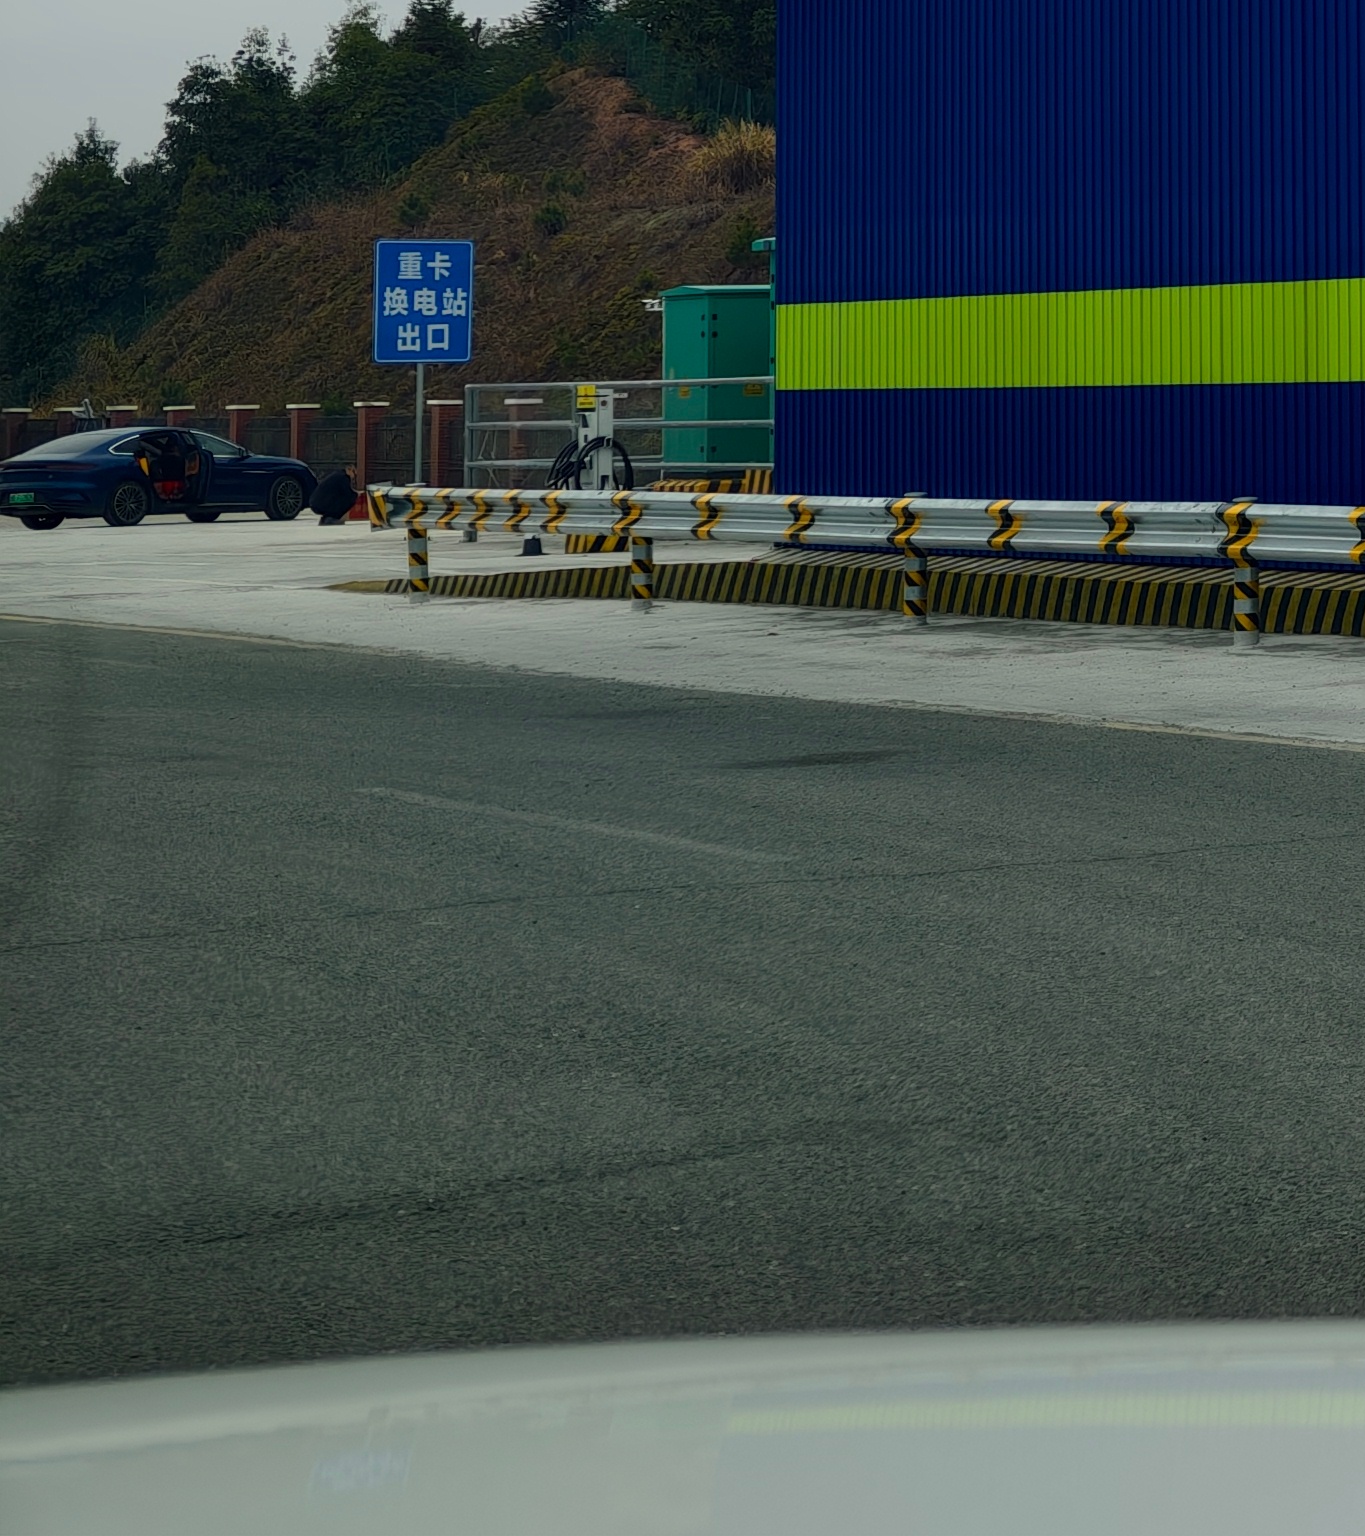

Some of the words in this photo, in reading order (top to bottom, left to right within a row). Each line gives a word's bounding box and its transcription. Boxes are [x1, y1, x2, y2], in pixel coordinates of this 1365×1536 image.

[397, 251, 452, 281] 重卡
[383, 286, 467, 317] 换电站
[396, 323, 450, 352] 出口
